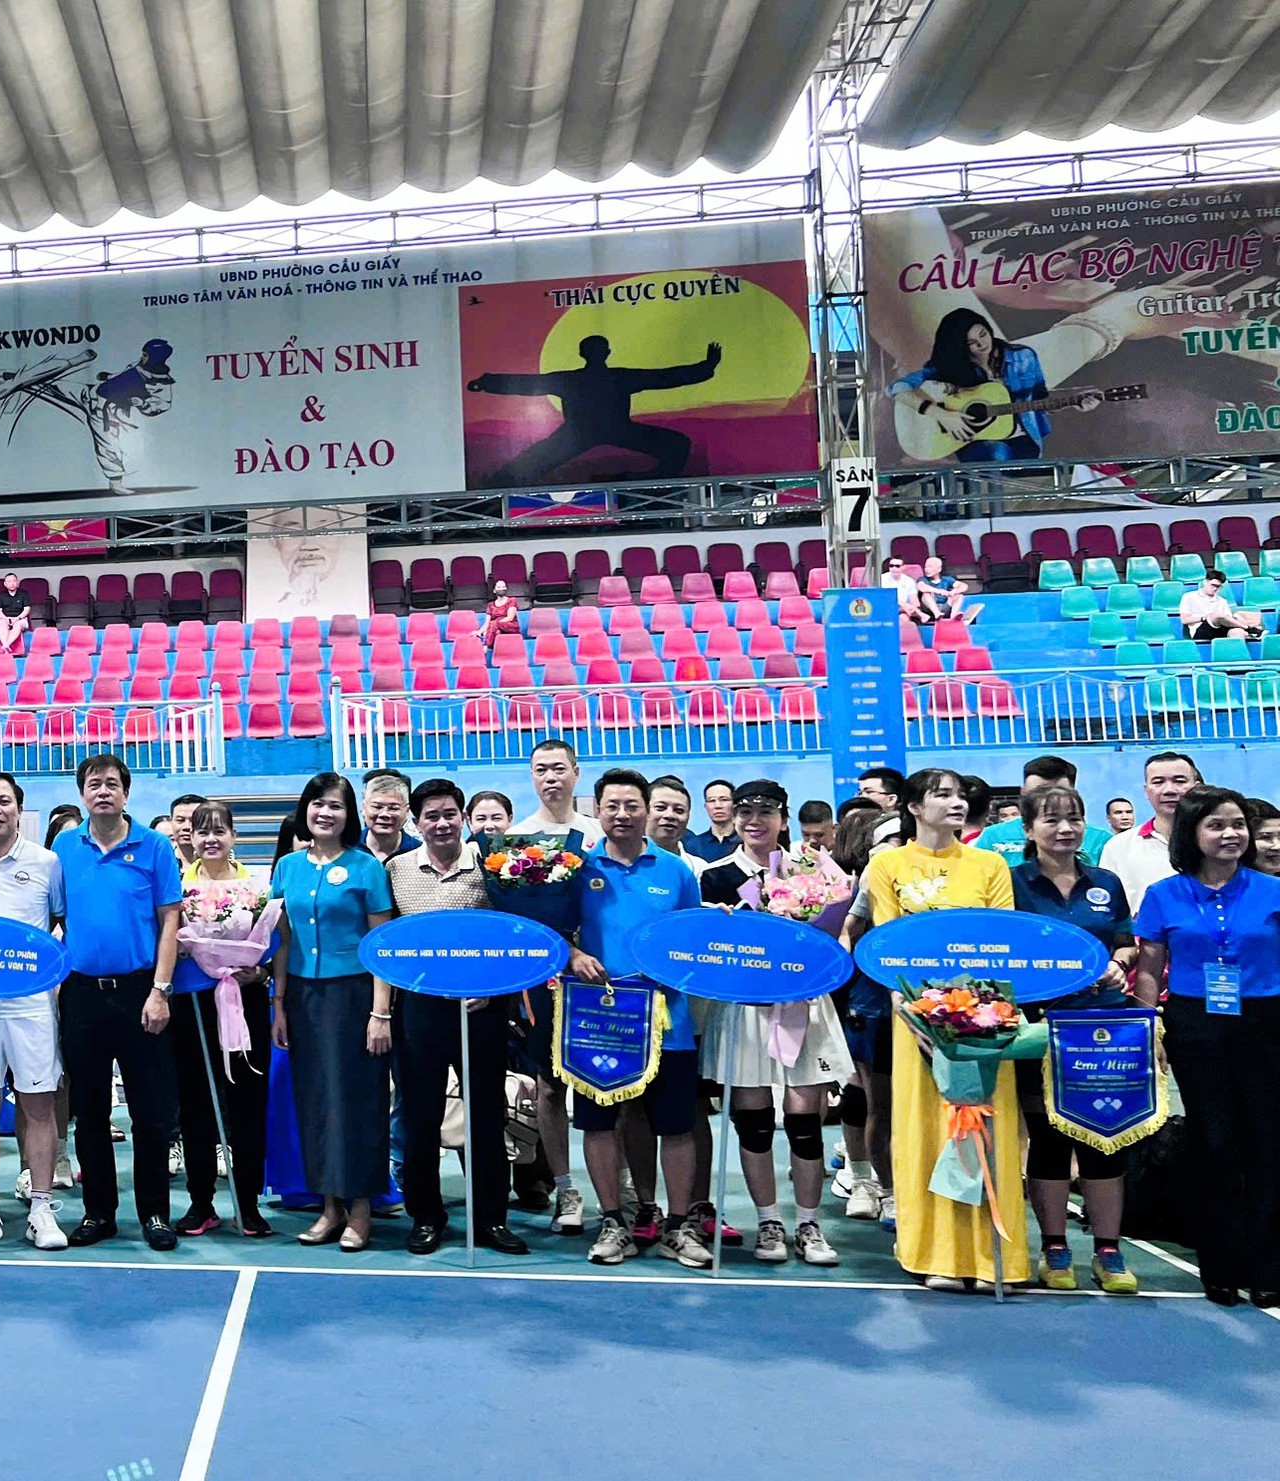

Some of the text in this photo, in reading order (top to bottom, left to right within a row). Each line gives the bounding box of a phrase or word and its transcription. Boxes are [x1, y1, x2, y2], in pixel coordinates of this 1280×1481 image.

[969, 229, 1021, 241] TRUNG
[1201, 210, 1226, 223] TIN
[1051, 205, 1092, 218] UBND
[219, 256, 401, 283] UBND PHƯỜNG CẦU GIẤY
[897, 248, 979, 293] CÂU
[991, 250, 1068, 292] LẠC
[1078, 237, 1137, 285] BỘ
[1147, 228, 1264, 275] NGHỆ
[143, 293, 189, 308] TRUNG
[192, 288, 223, 304] TÂM
[226, 286, 258, 302] VĂN
[261, 281, 294, 300] HOÁ
[306, 276, 355, 296] THÔNG
[358, 277, 383, 293] TIN
[387, 271, 410, 291] VÀ
[413, 267, 440, 289] THỂ
[443, 270, 484, 285] THAO
[552, 282, 604, 308] THÁI
[612, 283, 656, 306] CỰC
[1136, 291, 1234, 318] Guitar,
[205, 335, 420, 382] TUYỂN SINH
[300, 395, 326, 424] &
[234, 438, 396, 478] ĐÀO TẠO
[835, 466, 873, 483] SÂN
[841, 486, 871, 532] 7
